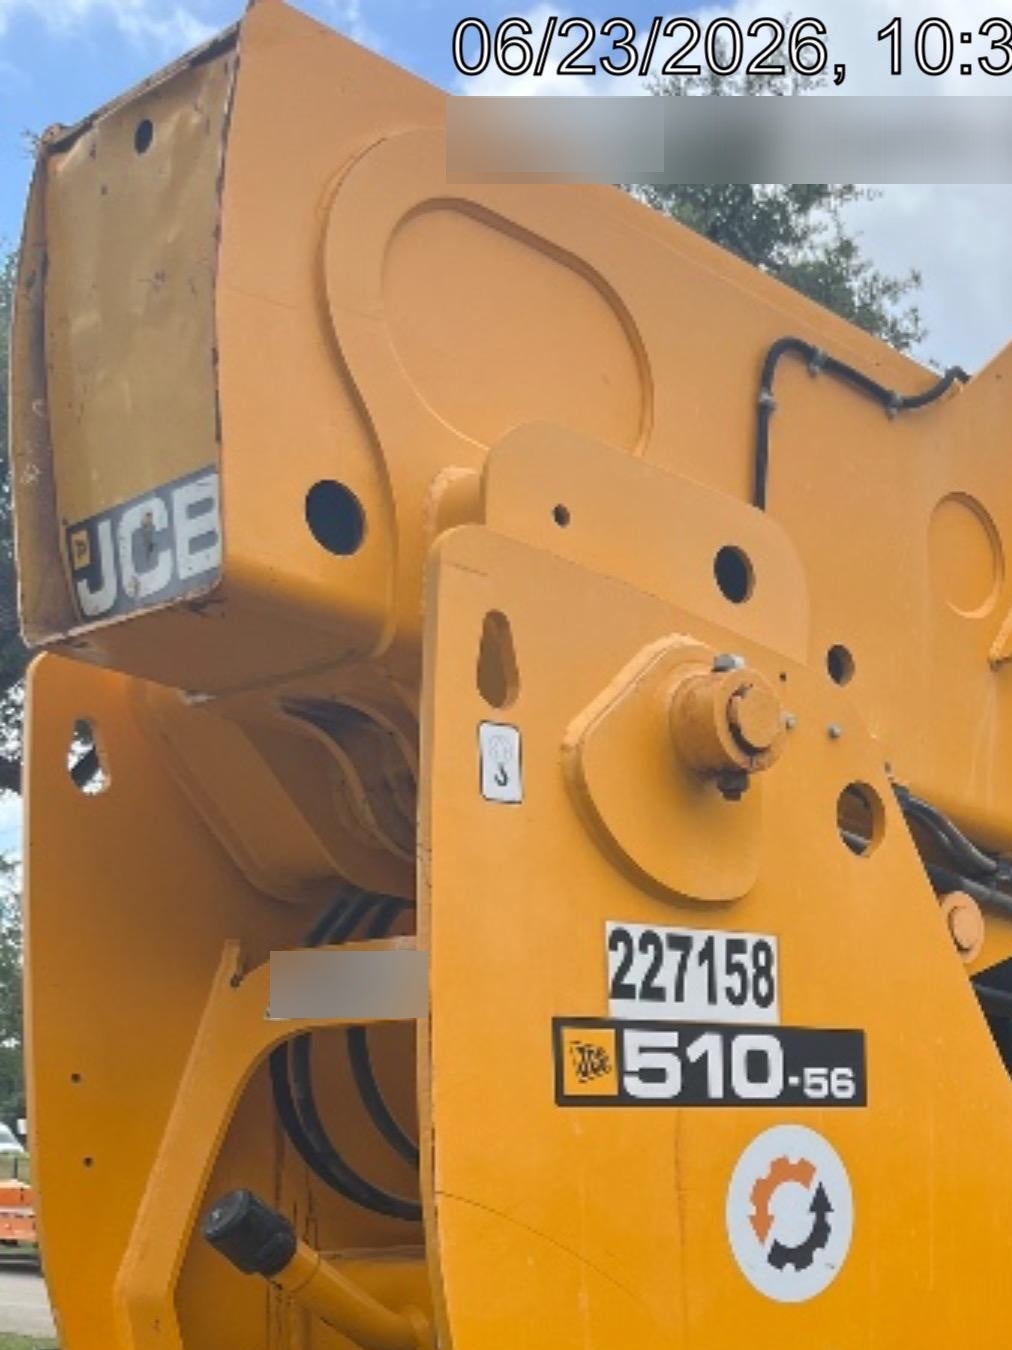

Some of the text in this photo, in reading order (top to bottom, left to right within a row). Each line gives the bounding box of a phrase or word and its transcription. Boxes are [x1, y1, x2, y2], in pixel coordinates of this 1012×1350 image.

[76, 473, 222, 616] JCB
[607, 926, 776, 1009] 227158
[622, 1027, 856, 1100] 510-56
